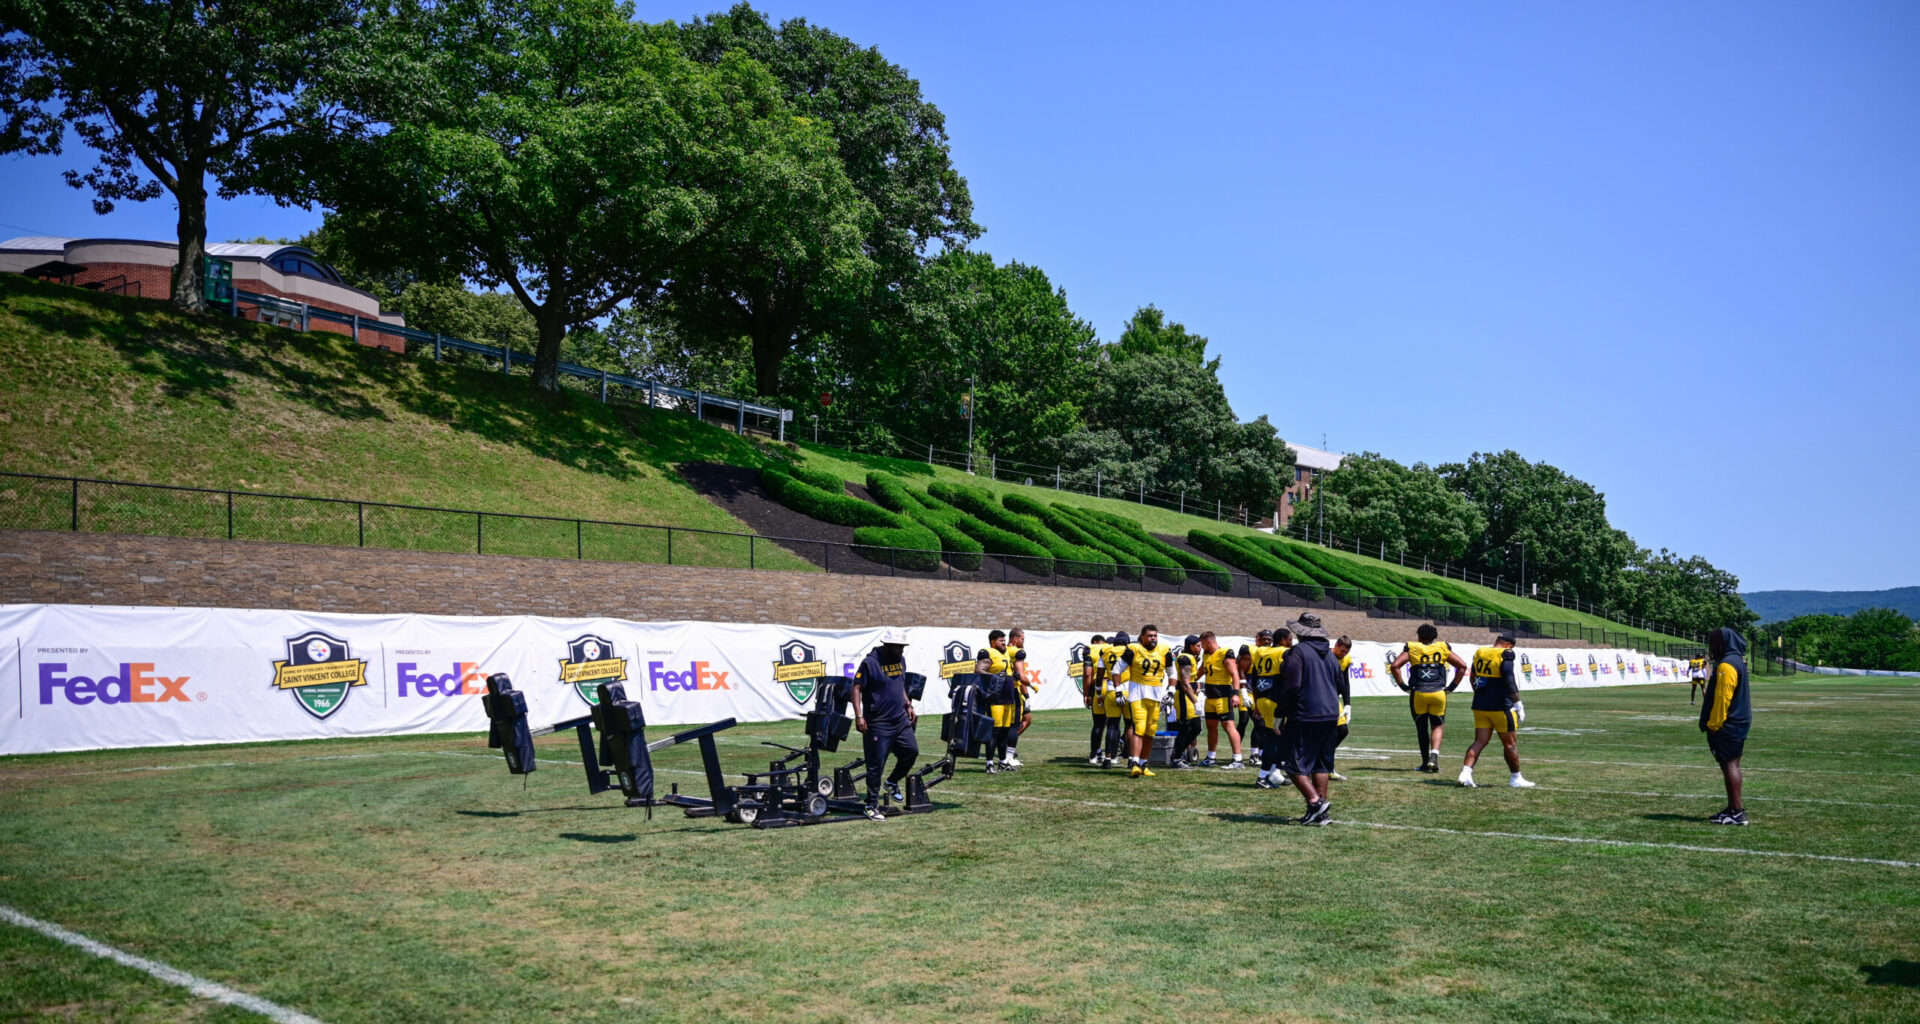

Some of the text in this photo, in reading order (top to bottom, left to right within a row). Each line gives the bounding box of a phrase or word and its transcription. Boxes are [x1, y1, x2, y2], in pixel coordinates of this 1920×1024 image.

[648, 661, 731, 691] FedEx
[1141, 658, 1161, 676] 97
[38, 662, 192, 705] FedEx
[283, 669, 357, 684] SAINT VINCENT COLLEGE
[313, 699, 330, 708] 1966
